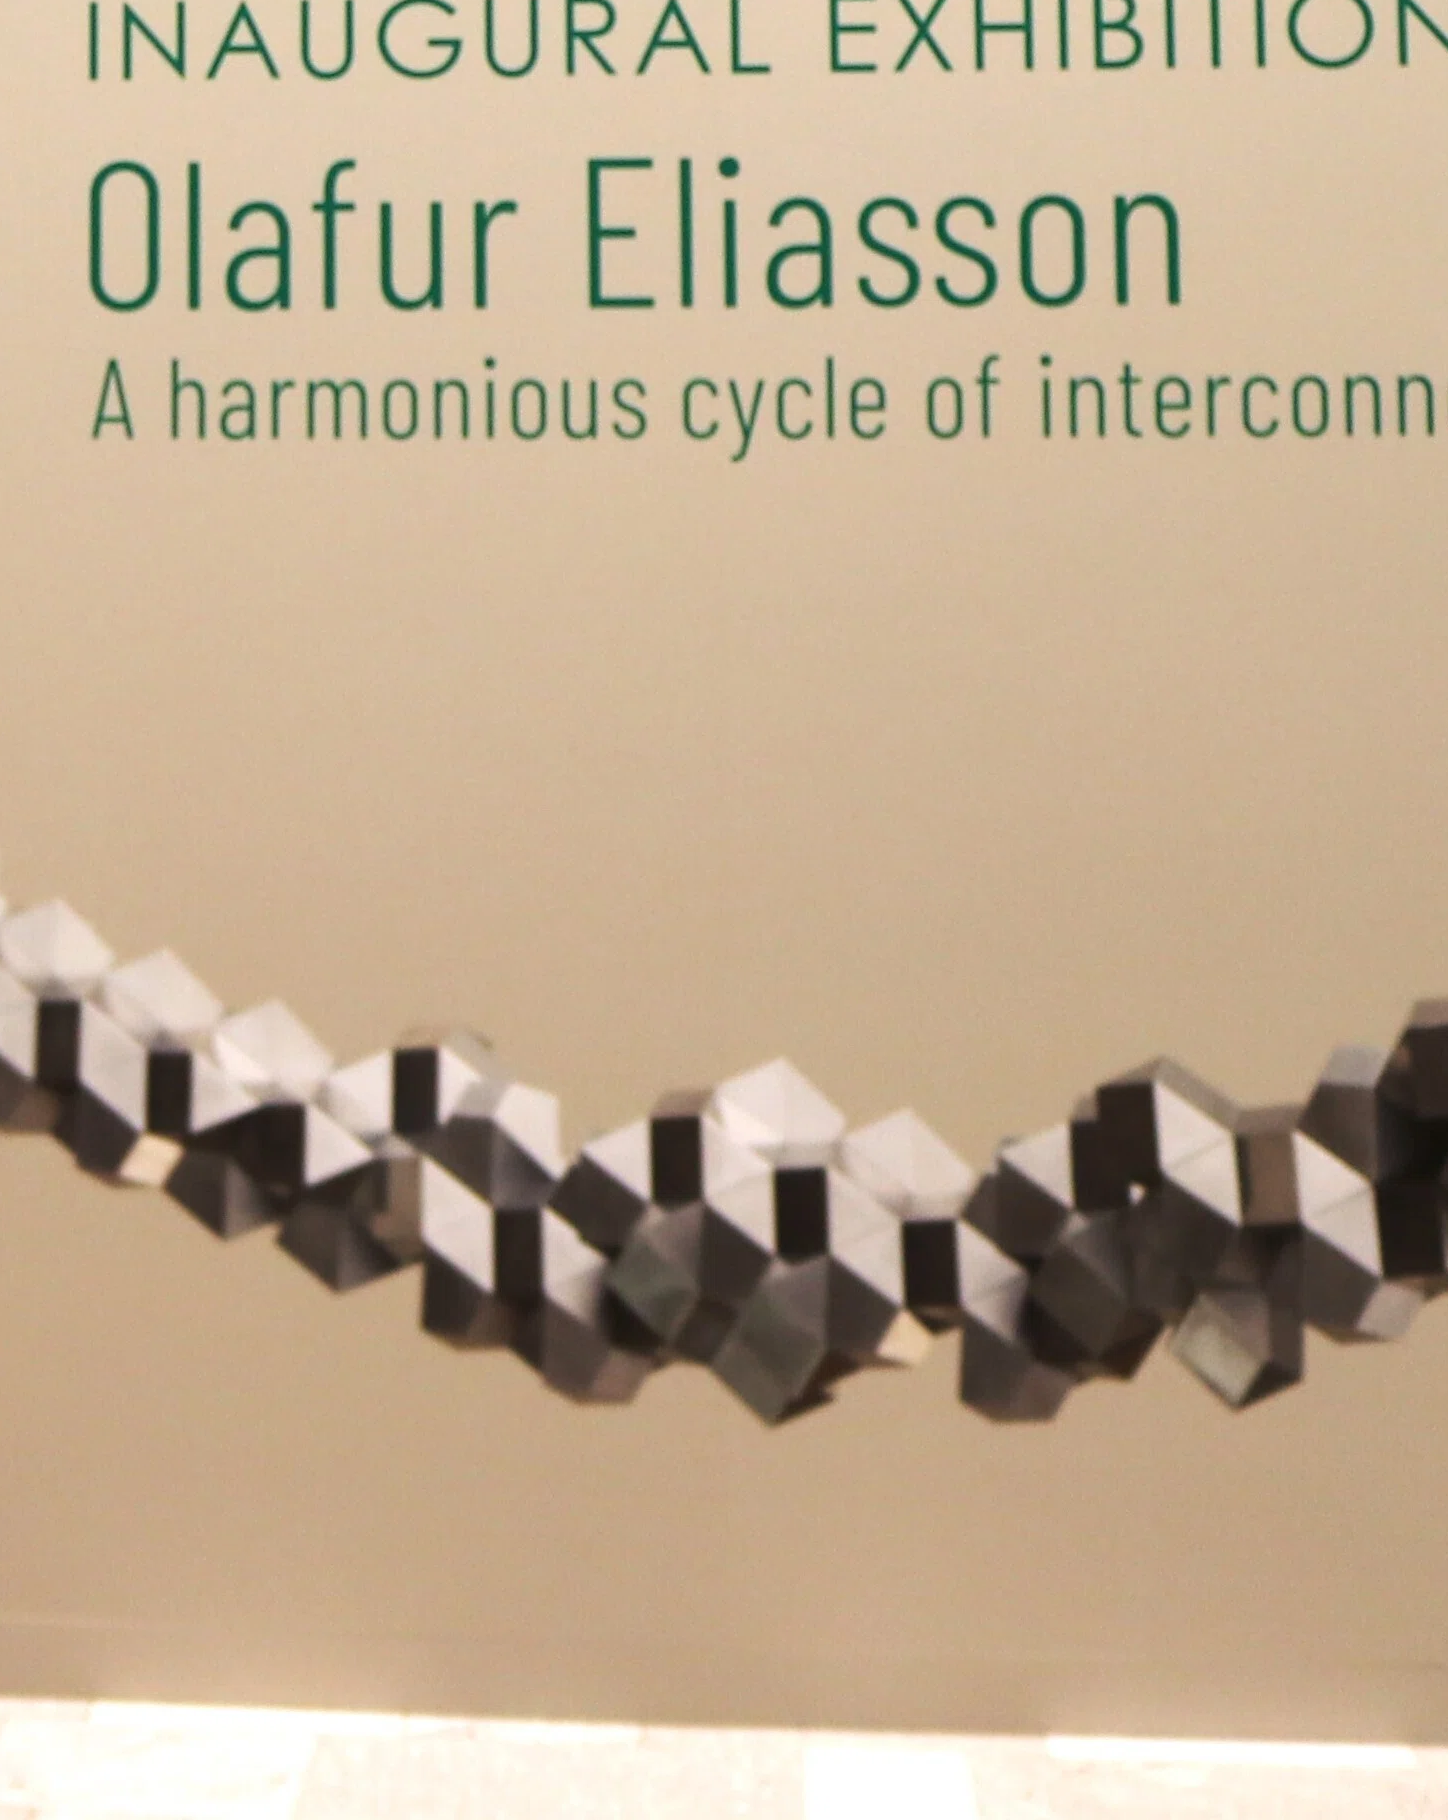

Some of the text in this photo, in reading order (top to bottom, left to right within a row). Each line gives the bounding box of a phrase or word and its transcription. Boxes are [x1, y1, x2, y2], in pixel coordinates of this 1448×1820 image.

[88, 155, 1183, 313] Olafur Eliasson
[93, 358, 134, 440] A
[170, 357, 647, 441] harmonious
[682, 356, 887, 462] cycle
[925, 353, 999, 439] of
